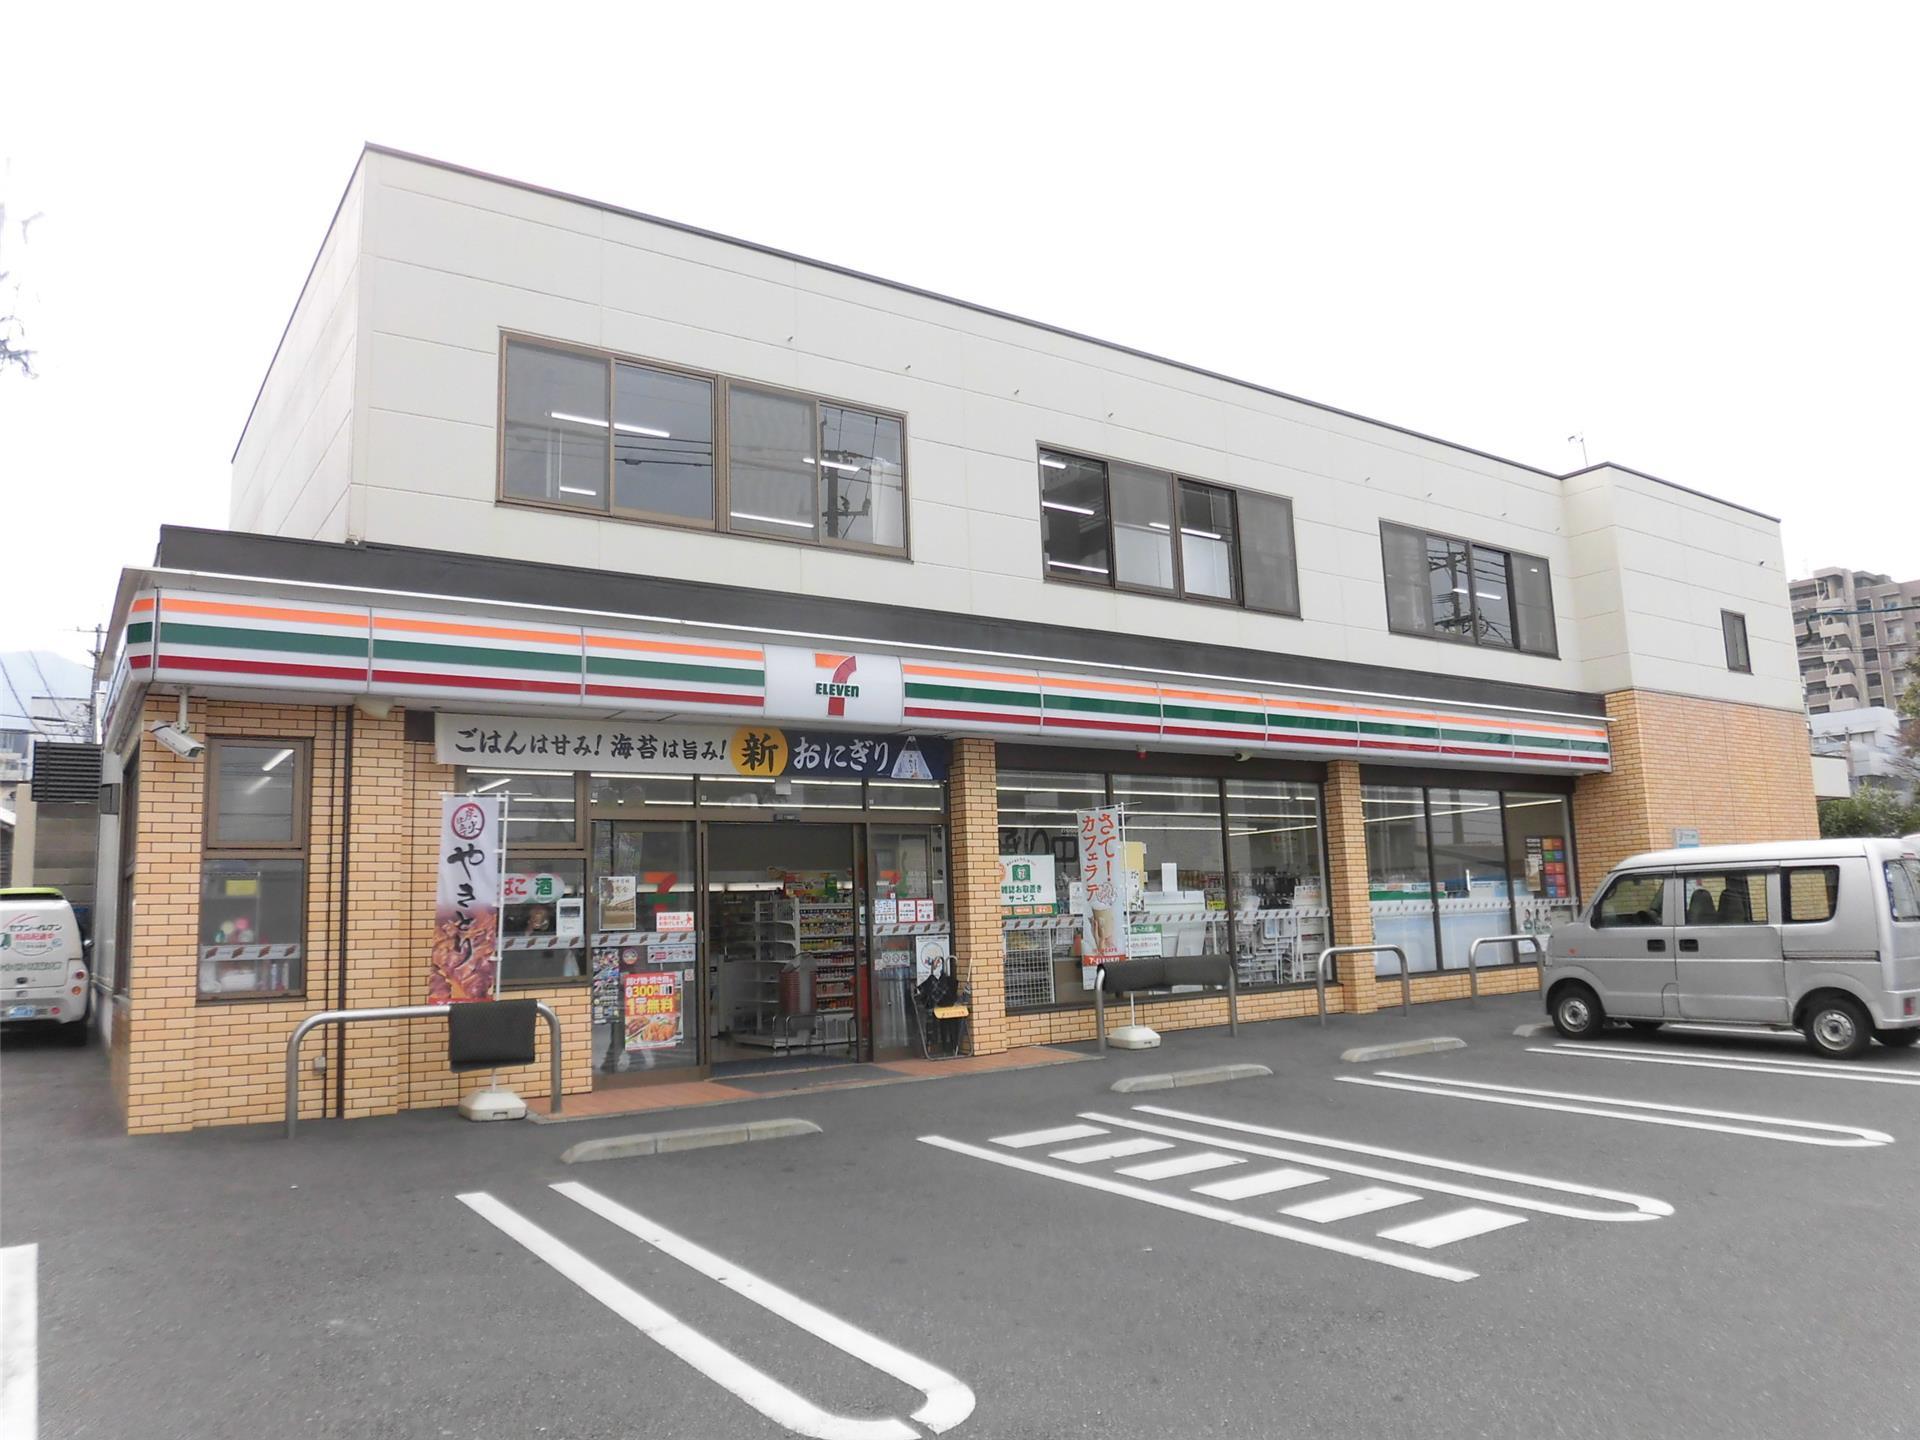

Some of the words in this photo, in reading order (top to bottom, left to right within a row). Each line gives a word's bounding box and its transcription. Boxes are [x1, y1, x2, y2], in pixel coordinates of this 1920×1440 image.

[455, 727, 602, 757] ごはんは甘み!
[610, 733, 728, 761] 海苔は旨み!
[741, 733, 778, 773] 新
[793, 736, 889, 771] おにぎり
[1081, 815, 1100, 902] カフェラテ
[1098, 813, 1117, 882] さて!
[446, 843, 486, 968] やきとり
[498, 878, 528, 896] ばこ
[535, 877, 553, 896] 酒
[1009, 895, 1036, 903] サービス
